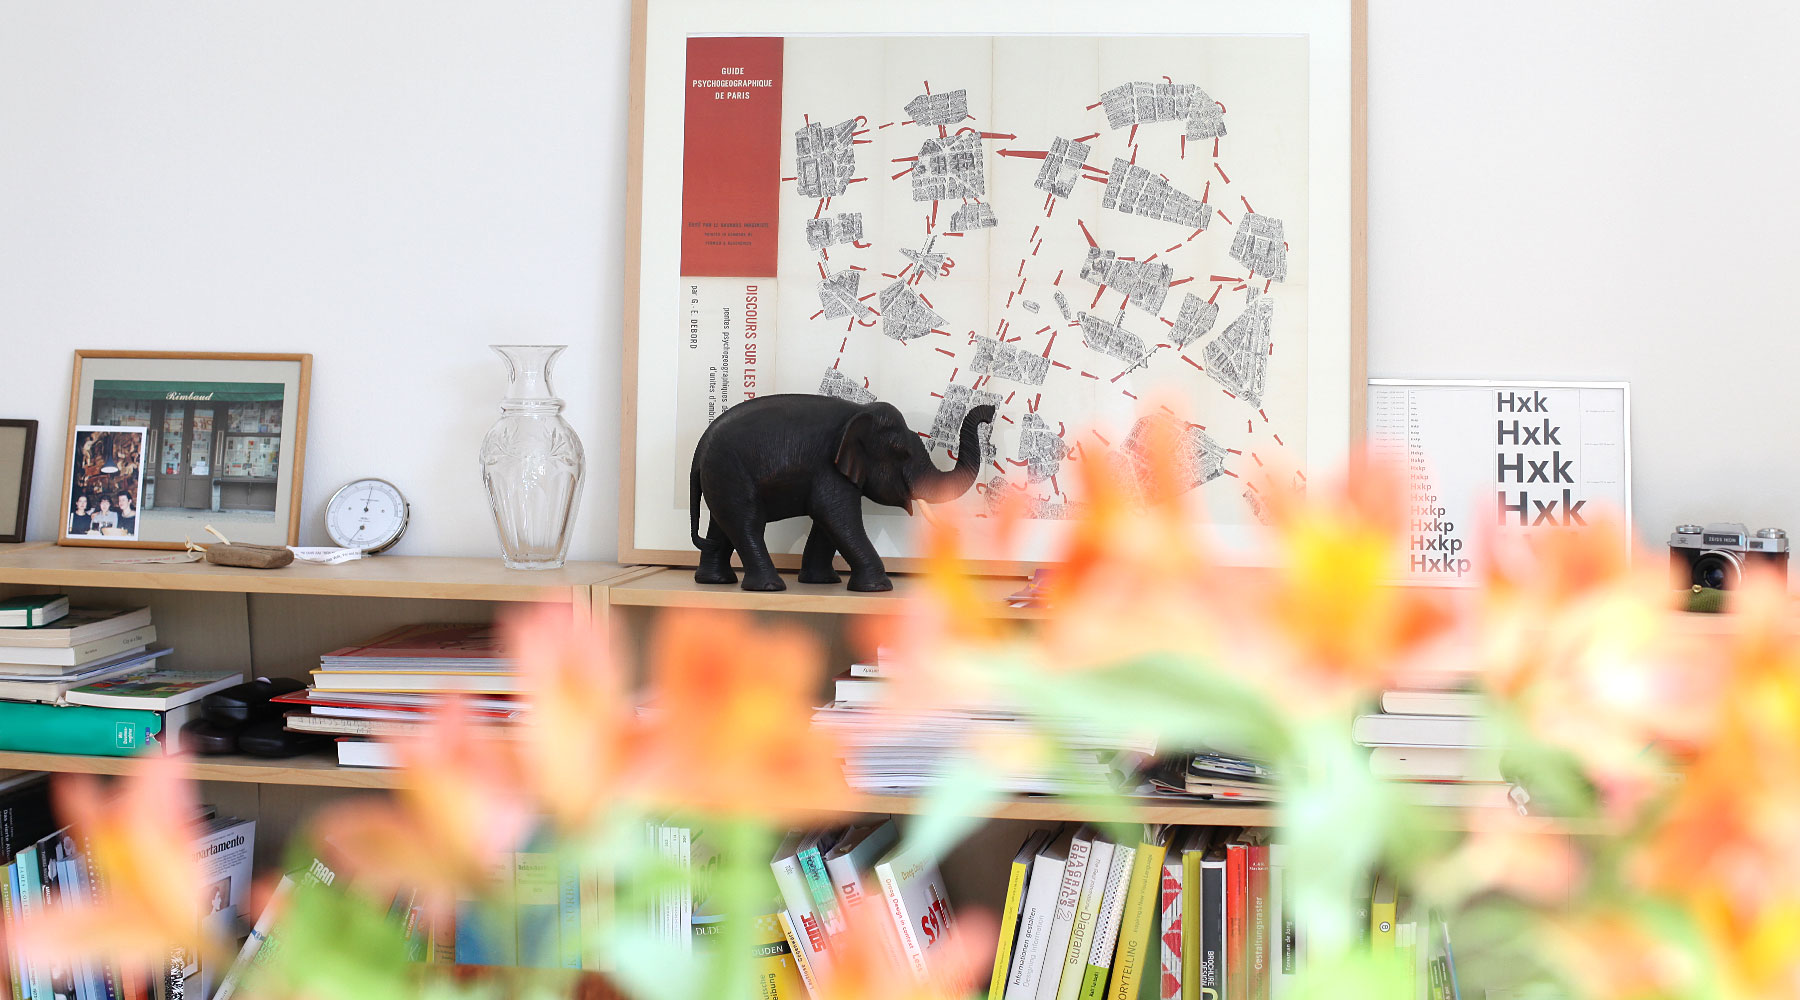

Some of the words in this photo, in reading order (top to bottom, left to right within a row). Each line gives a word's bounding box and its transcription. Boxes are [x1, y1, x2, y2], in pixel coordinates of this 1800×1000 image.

[721, 67, 745, 75] GUIDE
[692, 79, 772, 88] PSYCHOGEOGRAPHIQUE
[715, 92, 724, 100] DE
[727, 91, 750, 100] PARIS
[722, 307, 730, 330] pentes
[744, 285, 758, 339] DISCOURS
[689, 319, 698, 349] DEBORD
[744, 343, 757, 365] SUR
[743, 368, 756, 388] LES
[165, 391, 215, 401] Rimbaud
[1497, 391, 1549, 413] Hxk
[1497, 418, 1562, 446] Hxk
[1497, 451, 1575, 484] Hxk
[1410, 483, 1432, 492] Hxkp
[1410, 493, 1437, 504] Hxkp
[1410, 505, 1446, 519] Hxkp
[1497, 489, 1588, 527] Hxk
[1410, 518, 1455, 536] Hxkp
[1410, 534, 1463, 556] Hxkp
[1410, 553, 1472, 578] Hxkp
[308, 857, 336, 887] TRAN
[1059, 843, 1080, 907] GRAPHICS
[1066, 844, 1088, 908] DIAGRAM
[841, 881, 862, 908] bill
[892, 898, 903, 919] Design
[1056, 908, 1073, 922] 2
[900, 918, 905, 927] in
[1254, 896, 1264, 970] Gestaltungsraster
[787, 931, 803, 963] Gegenwart
[902, 926, 914, 949] context
[1013, 939, 1030, 986] Informationen
[1025, 907, 1037, 939] gestalten
[1069, 911, 1091, 965] Diagrams
[1285, 933, 1291, 942] de
[751, 945, 784, 956] DUDEN
[1022, 954, 1038, 988] Designing
[1031, 915, 1045, 953] Information
[780, 958, 787, 968] 1
[1207, 950, 1215, 986] BROCHURE
